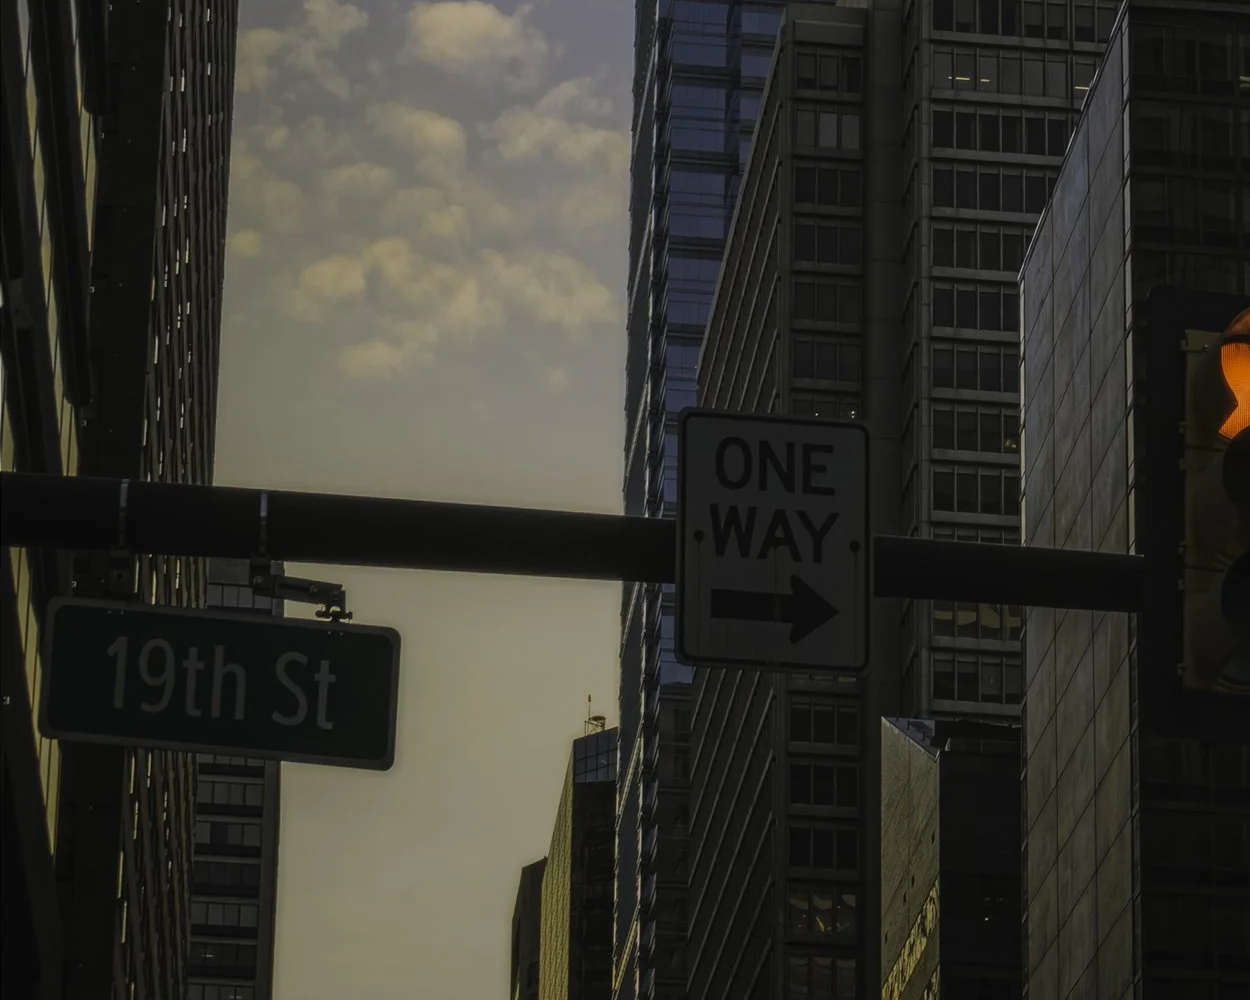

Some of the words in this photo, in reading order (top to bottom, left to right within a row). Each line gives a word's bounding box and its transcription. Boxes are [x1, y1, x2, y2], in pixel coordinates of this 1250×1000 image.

[715, 436, 835, 497] ONE
[709, 502, 840, 563] WAY
[107, 635, 246, 720] 19th
[271, 650, 337, 730] St
